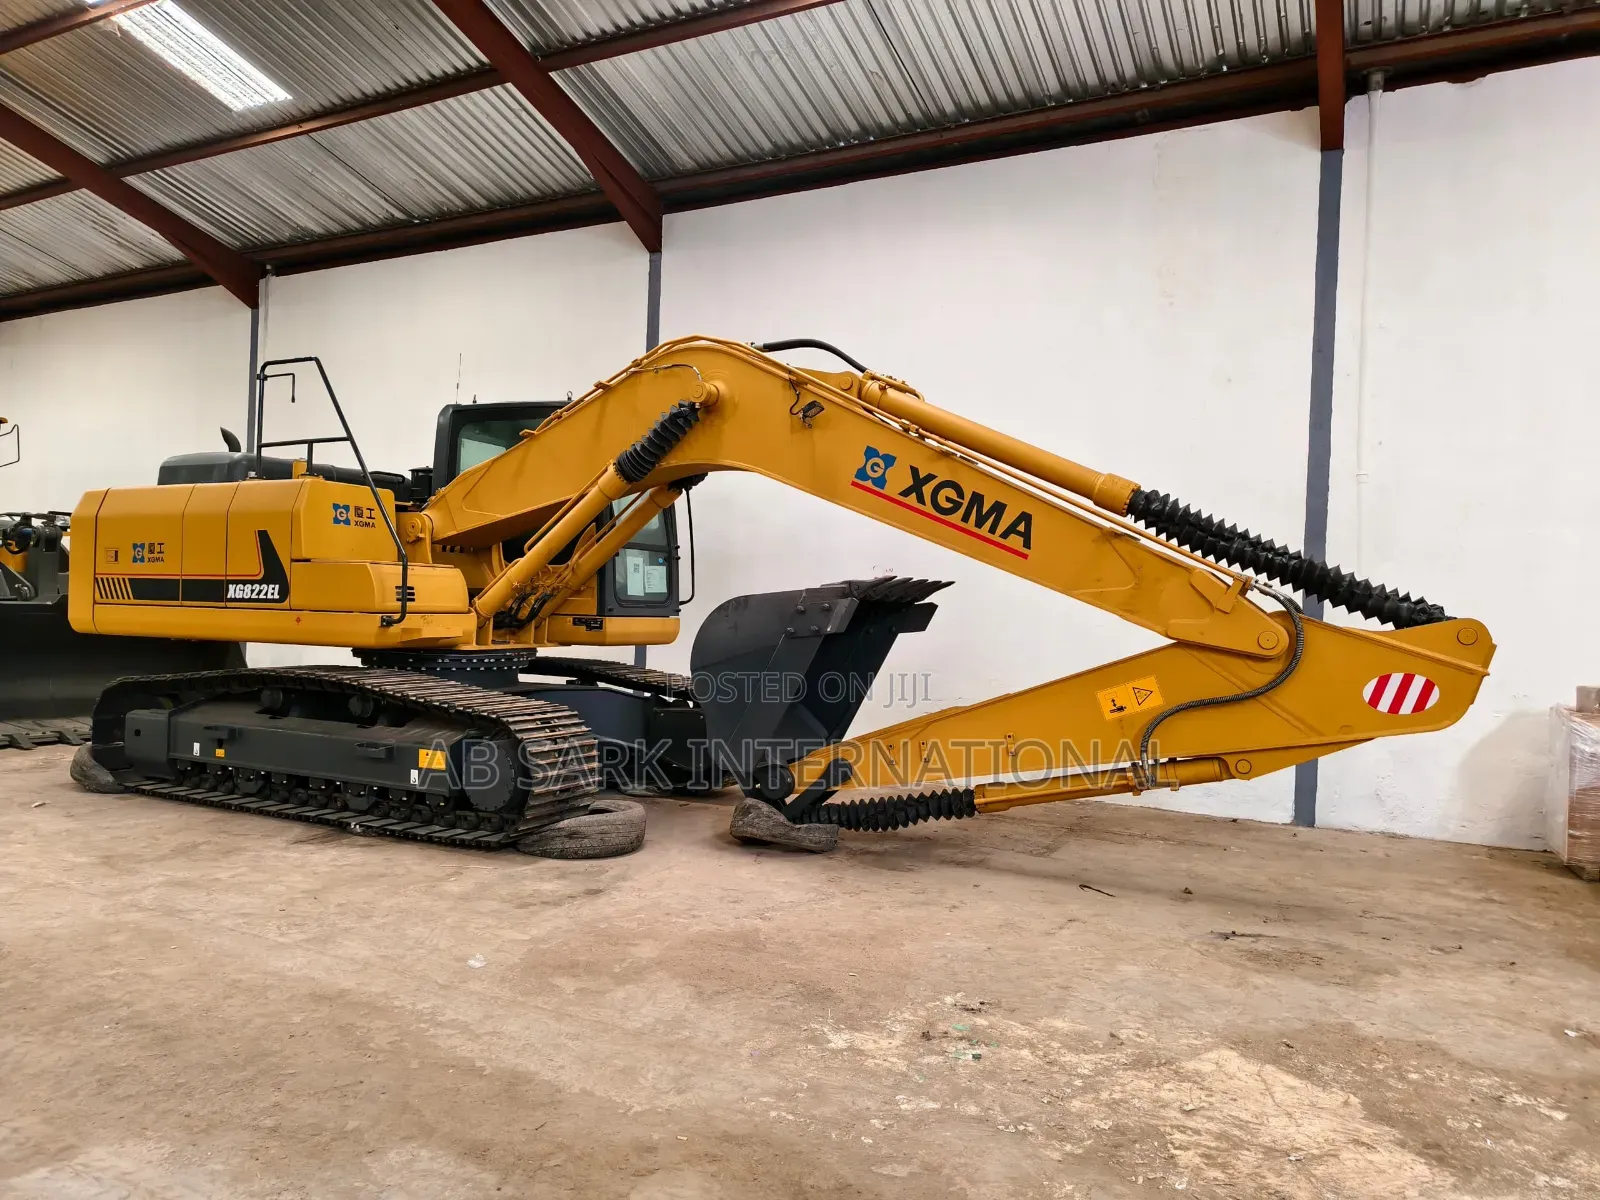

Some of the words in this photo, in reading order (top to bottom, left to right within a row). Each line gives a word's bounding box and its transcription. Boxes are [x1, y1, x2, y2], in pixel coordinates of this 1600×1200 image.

[898, 464, 1033, 551] XGMA
[353, 520, 377, 529] XGMA
[147, 556, 165, 564] XGMA
[226, 583, 280, 599] XG822EL
